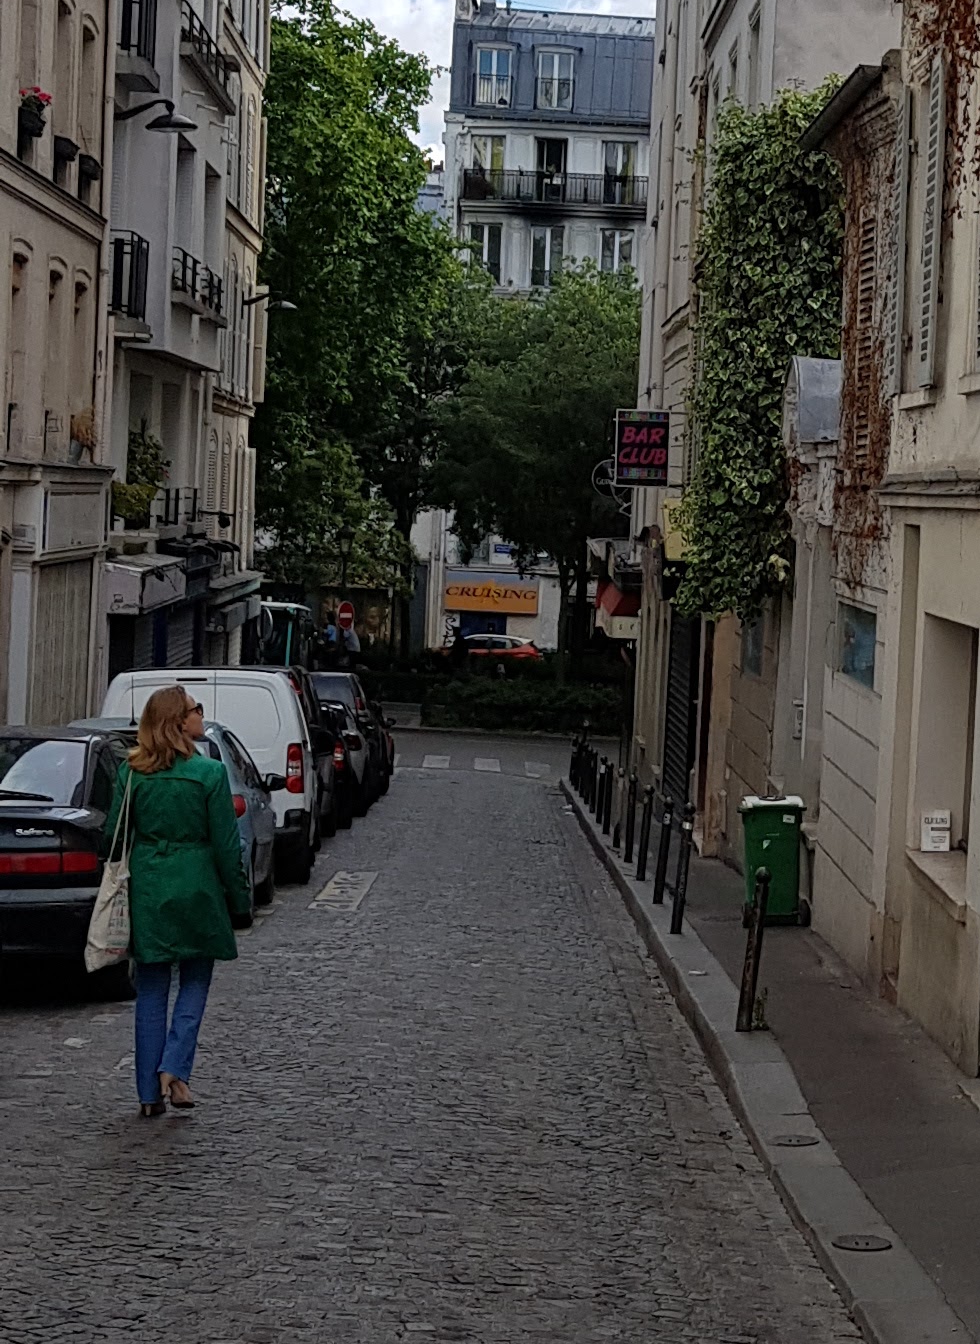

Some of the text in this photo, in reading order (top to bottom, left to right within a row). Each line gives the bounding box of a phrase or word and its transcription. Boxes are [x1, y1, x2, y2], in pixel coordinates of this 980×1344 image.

[621, 426, 665, 443] BAR
[618, 447, 667, 465] CLUB
[445, 586, 537, 600] CRUISING
